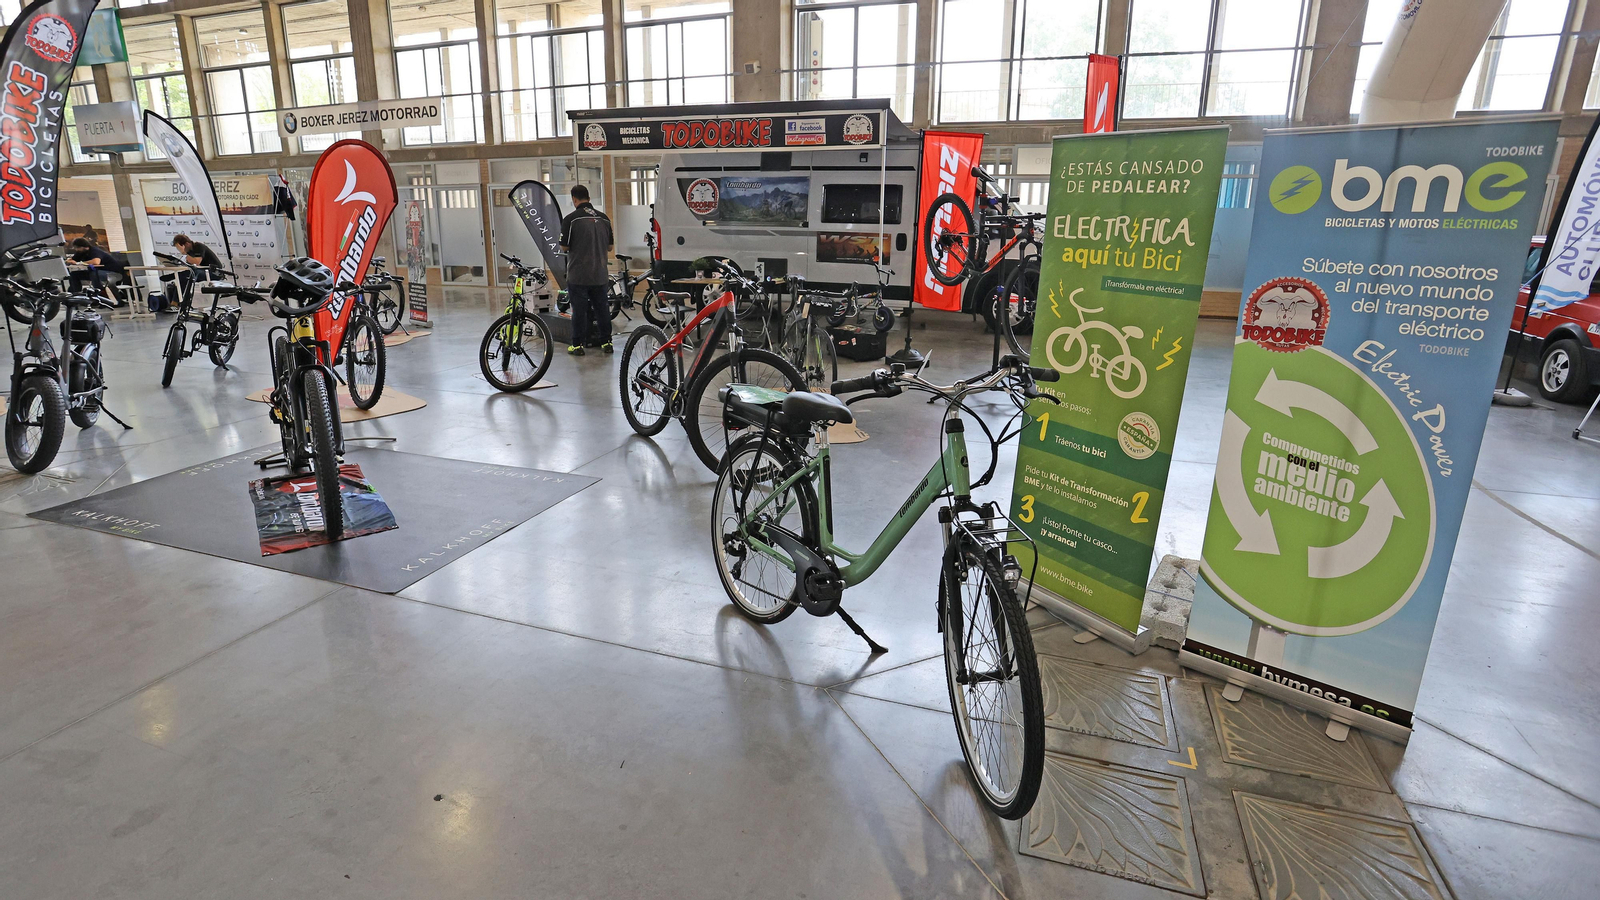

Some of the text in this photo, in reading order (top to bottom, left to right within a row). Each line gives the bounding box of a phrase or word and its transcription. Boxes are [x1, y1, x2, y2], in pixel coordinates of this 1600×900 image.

[25, 34, 72, 63] TODOBIKE
[84, 120, 125, 136] PUERTA 1
[300, 105, 438, 128] BOXER JEREZ MOTORRAD
[0, 61, 47, 224] TODOBIKE
[620, 127, 650, 135] BICICLETAS
[661, 119, 773, 148] TODOBIKE
[39, 91, 62, 222] BICICLETAS
[1485, 145, 1545, 157] TODOBIKE
[1060, 159, 1204, 179] ¿ESTÁS CANSADO
[214, 181, 240, 193] EREZ
[1066, 179, 1191, 194] DE PEDALEAR?
[1330, 158, 1529, 213] bme
[154, 194, 187, 202] CONCESIONARIO
[217, 194, 238, 202] OTORRAD
[1324, 217, 1519, 230] BICICLETAS Y MOTOS ELÉCTRICAS
[1556, 156, 1600, 276] AUTOMÓV
[1062, 244, 1182, 272] aquí tu Bici
[1302, 257, 1499, 281] Súbete con nosotros
[1105, 279, 1144, 291] ¡Transfórmala
[1155, 285, 1185, 295] eléctrica!
[1334, 278, 1494, 302] al nuevo mundo
[1351, 298, 1489, 322] del transporte
[1241, 324, 1326, 346] TODOBIKE
[1398, 320, 1485, 341] eléctrico
[1419, 343, 1470, 357] TODOBIKE
[1035, 385, 1066, 399] Tu Kit en
[1069, 403, 1092, 415] pasos:
[1352, 340, 1453, 478] Electric Power
[1036, 412, 1050, 442] 1
[1126, 426, 1151, 446] ESPAÑA
[1055, 434, 1107, 459] Tráenos tu bici
[1262, 431, 1360, 475] Comprometidos
[1286, 453, 1320, 472] con el
[472, 468, 565, 484] KALKHOFF
[1025, 464, 1129, 508] Pide tu Kit de Transformación
[1257, 450, 1355, 504] medio
[1024, 475, 1098, 509] BME y te lo instalamos
[1253, 477, 1351, 522] ambiente
[71, 509, 161, 530] KALKHOFF
[1018, 494, 1035, 524] 3
[1130, 491, 1150, 524] 2
[401, 518, 503, 572] KALKHOFF
[1040, 527, 1078, 549] ¡y arranca!
[1042, 516, 1118, 554] ¡Listo! Ponte tu casco...
[1040, 565, 1094, 597] www.bme.bike
